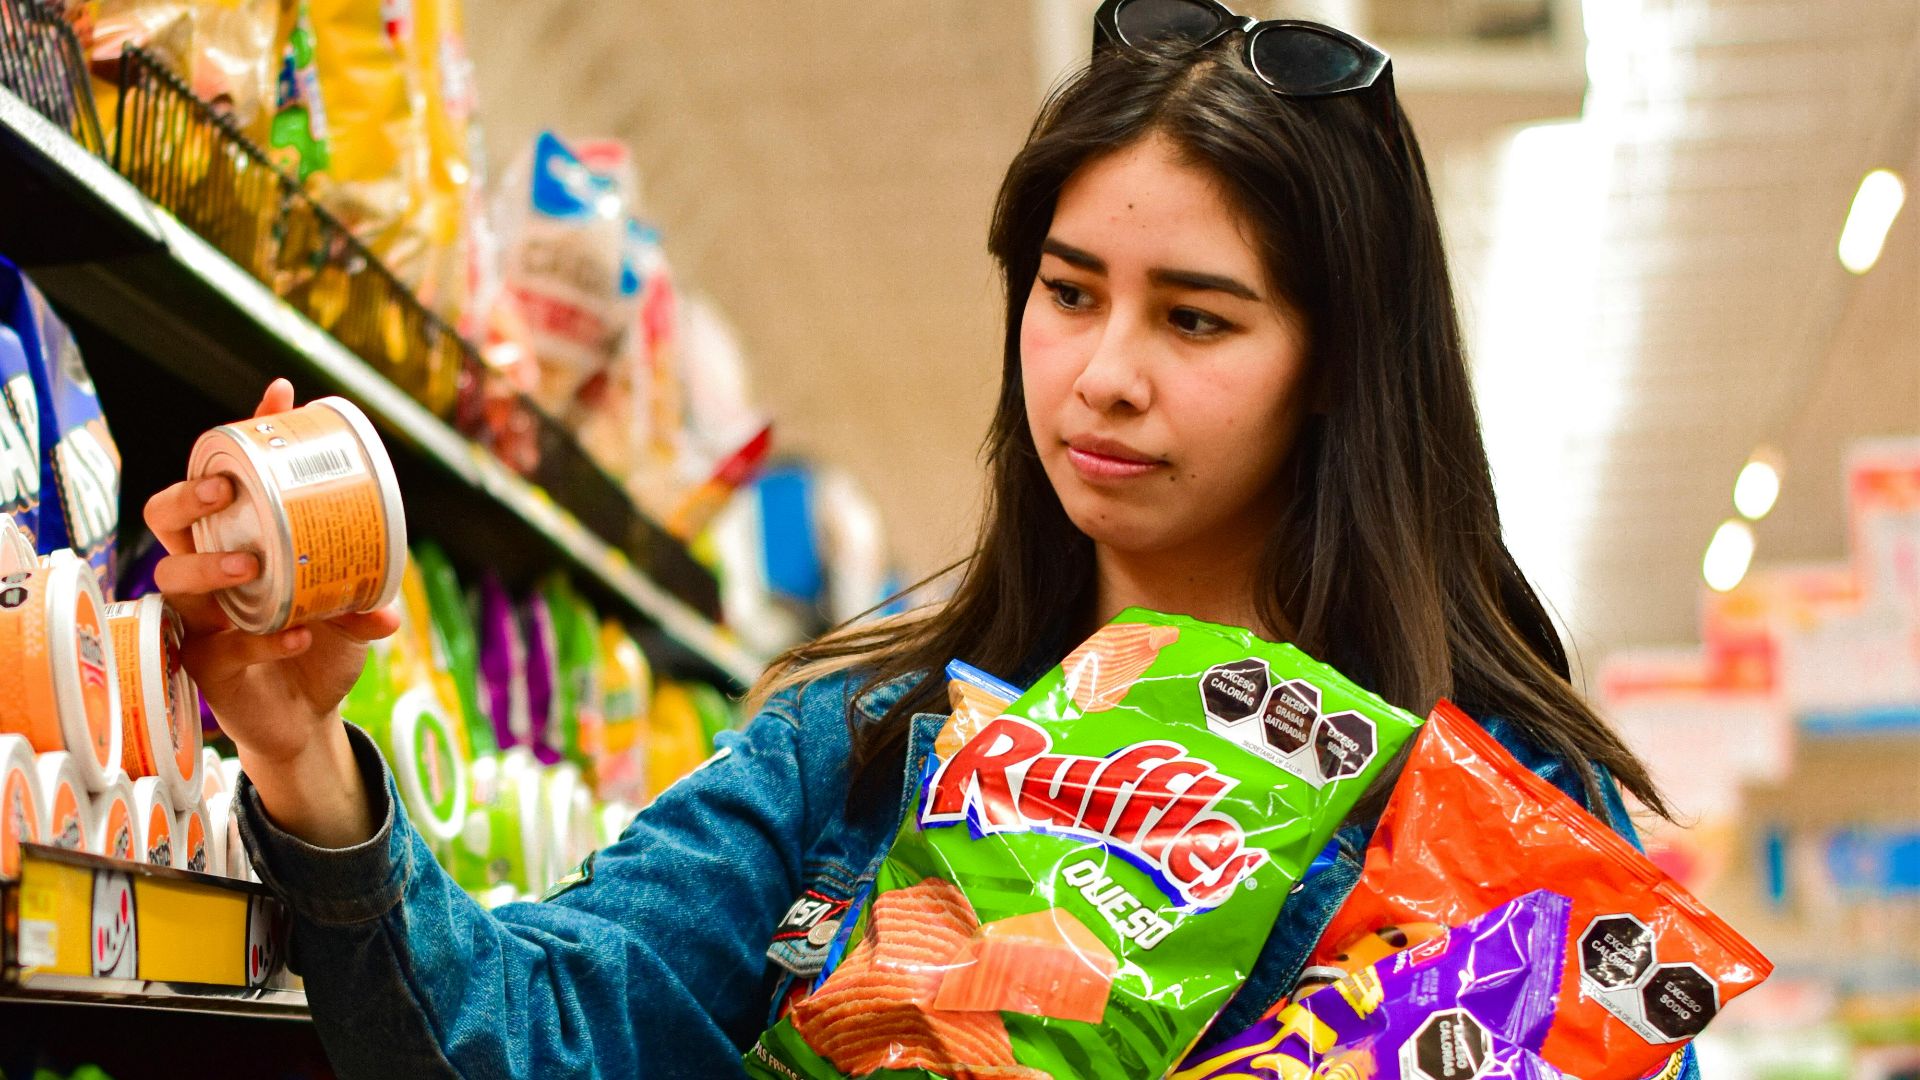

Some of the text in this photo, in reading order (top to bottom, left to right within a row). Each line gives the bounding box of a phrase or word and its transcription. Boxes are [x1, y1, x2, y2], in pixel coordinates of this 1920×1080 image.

[1211, 678, 1254, 707] CALORÍAS
[1222, 669, 1257, 692] EXCESO
[1275, 705, 1305, 728] GRASAS
[1280, 693, 1309, 715] EXCESO
[1265, 714, 1307, 743] SATURADAS
[1327, 727, 1360, 752] EXCESO
[924, 714, 1270, 910] Ruffles
[1062, 859, 1176, 951] QUESO
[1603, 933, 1638, 962] EXCESO
[1659, 994, 1691, 1020] SODIO
[1664, 981, 1701, 1013] EXCESO
[1453, 1024, 1468, 1069] EXCESO
